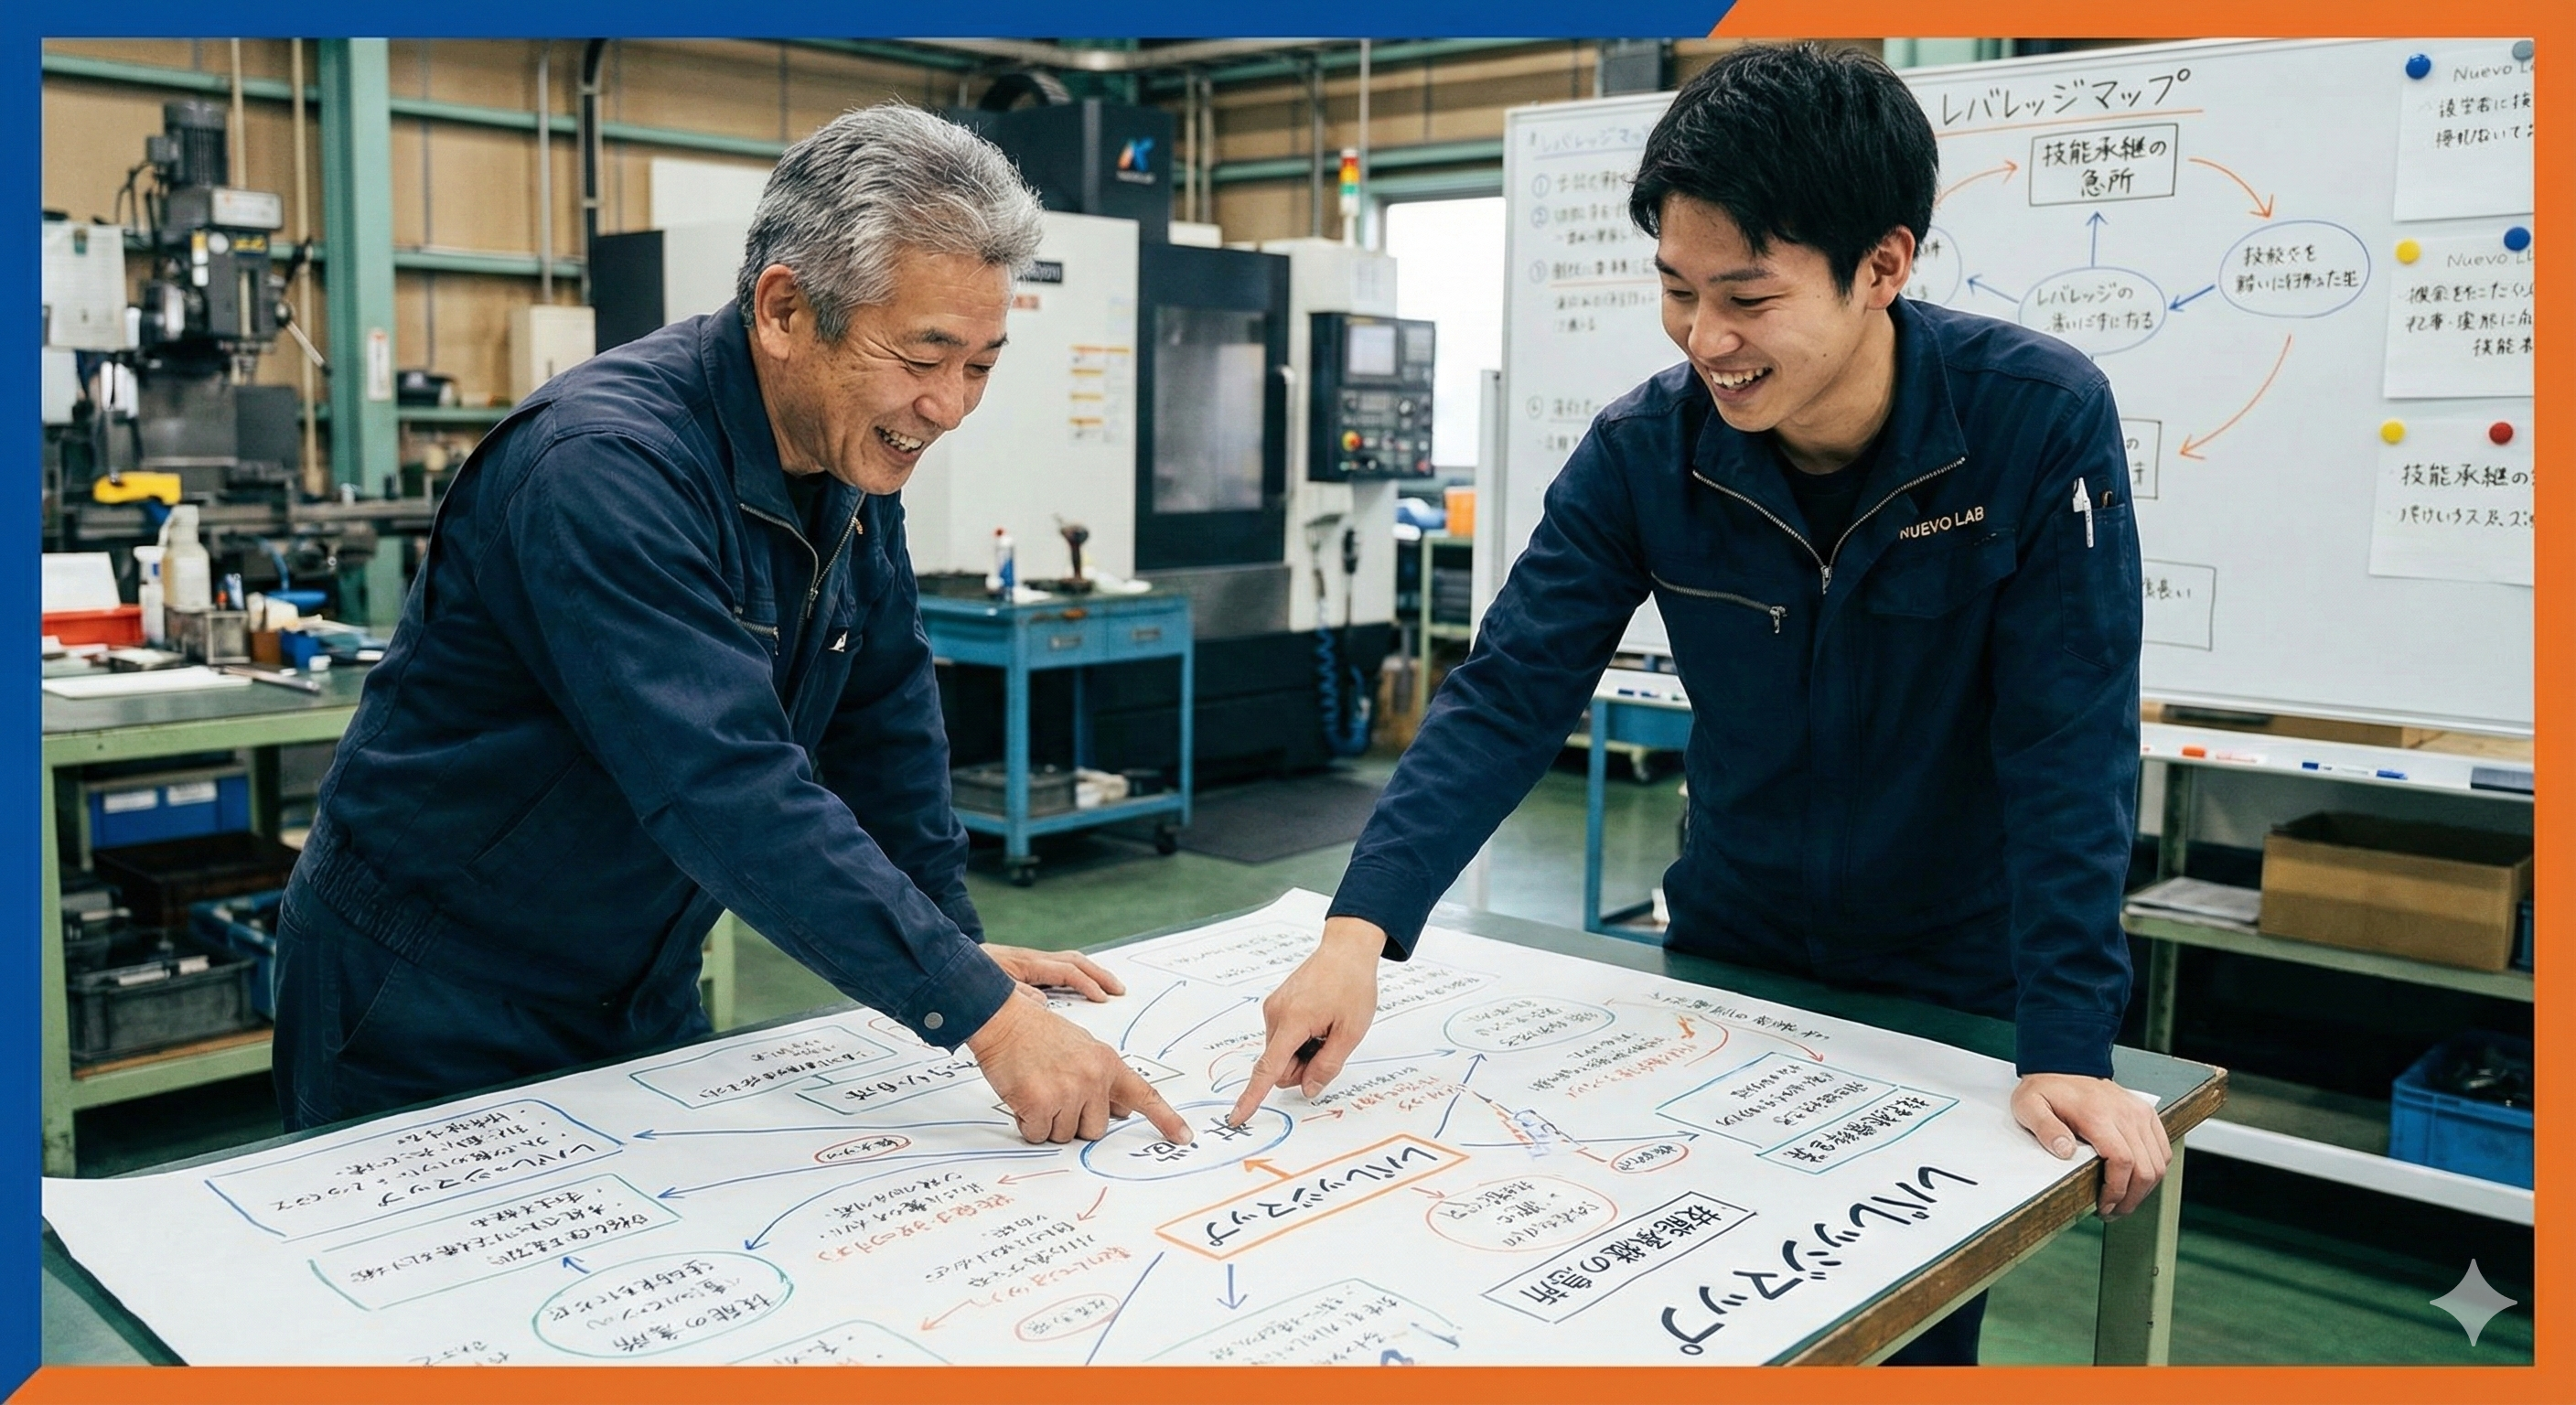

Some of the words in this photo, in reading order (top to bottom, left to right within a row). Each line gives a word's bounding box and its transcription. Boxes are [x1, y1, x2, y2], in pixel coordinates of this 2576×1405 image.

[2453, 64, 2513, 82] Nuevo
[1942, 69, 2192, 126] レバレッジマップ
[2043, 135, 2168, 168] 技能承継の
[2081, 166, 2136, 198] 急所
[2036, 281, 2134, 306] レバレッジの
[2401, 462, 2534, 488] 技能承継の
[1900, 516, 1952, 540] NUEVO
[1955, 506, 1984, 527] LAB
